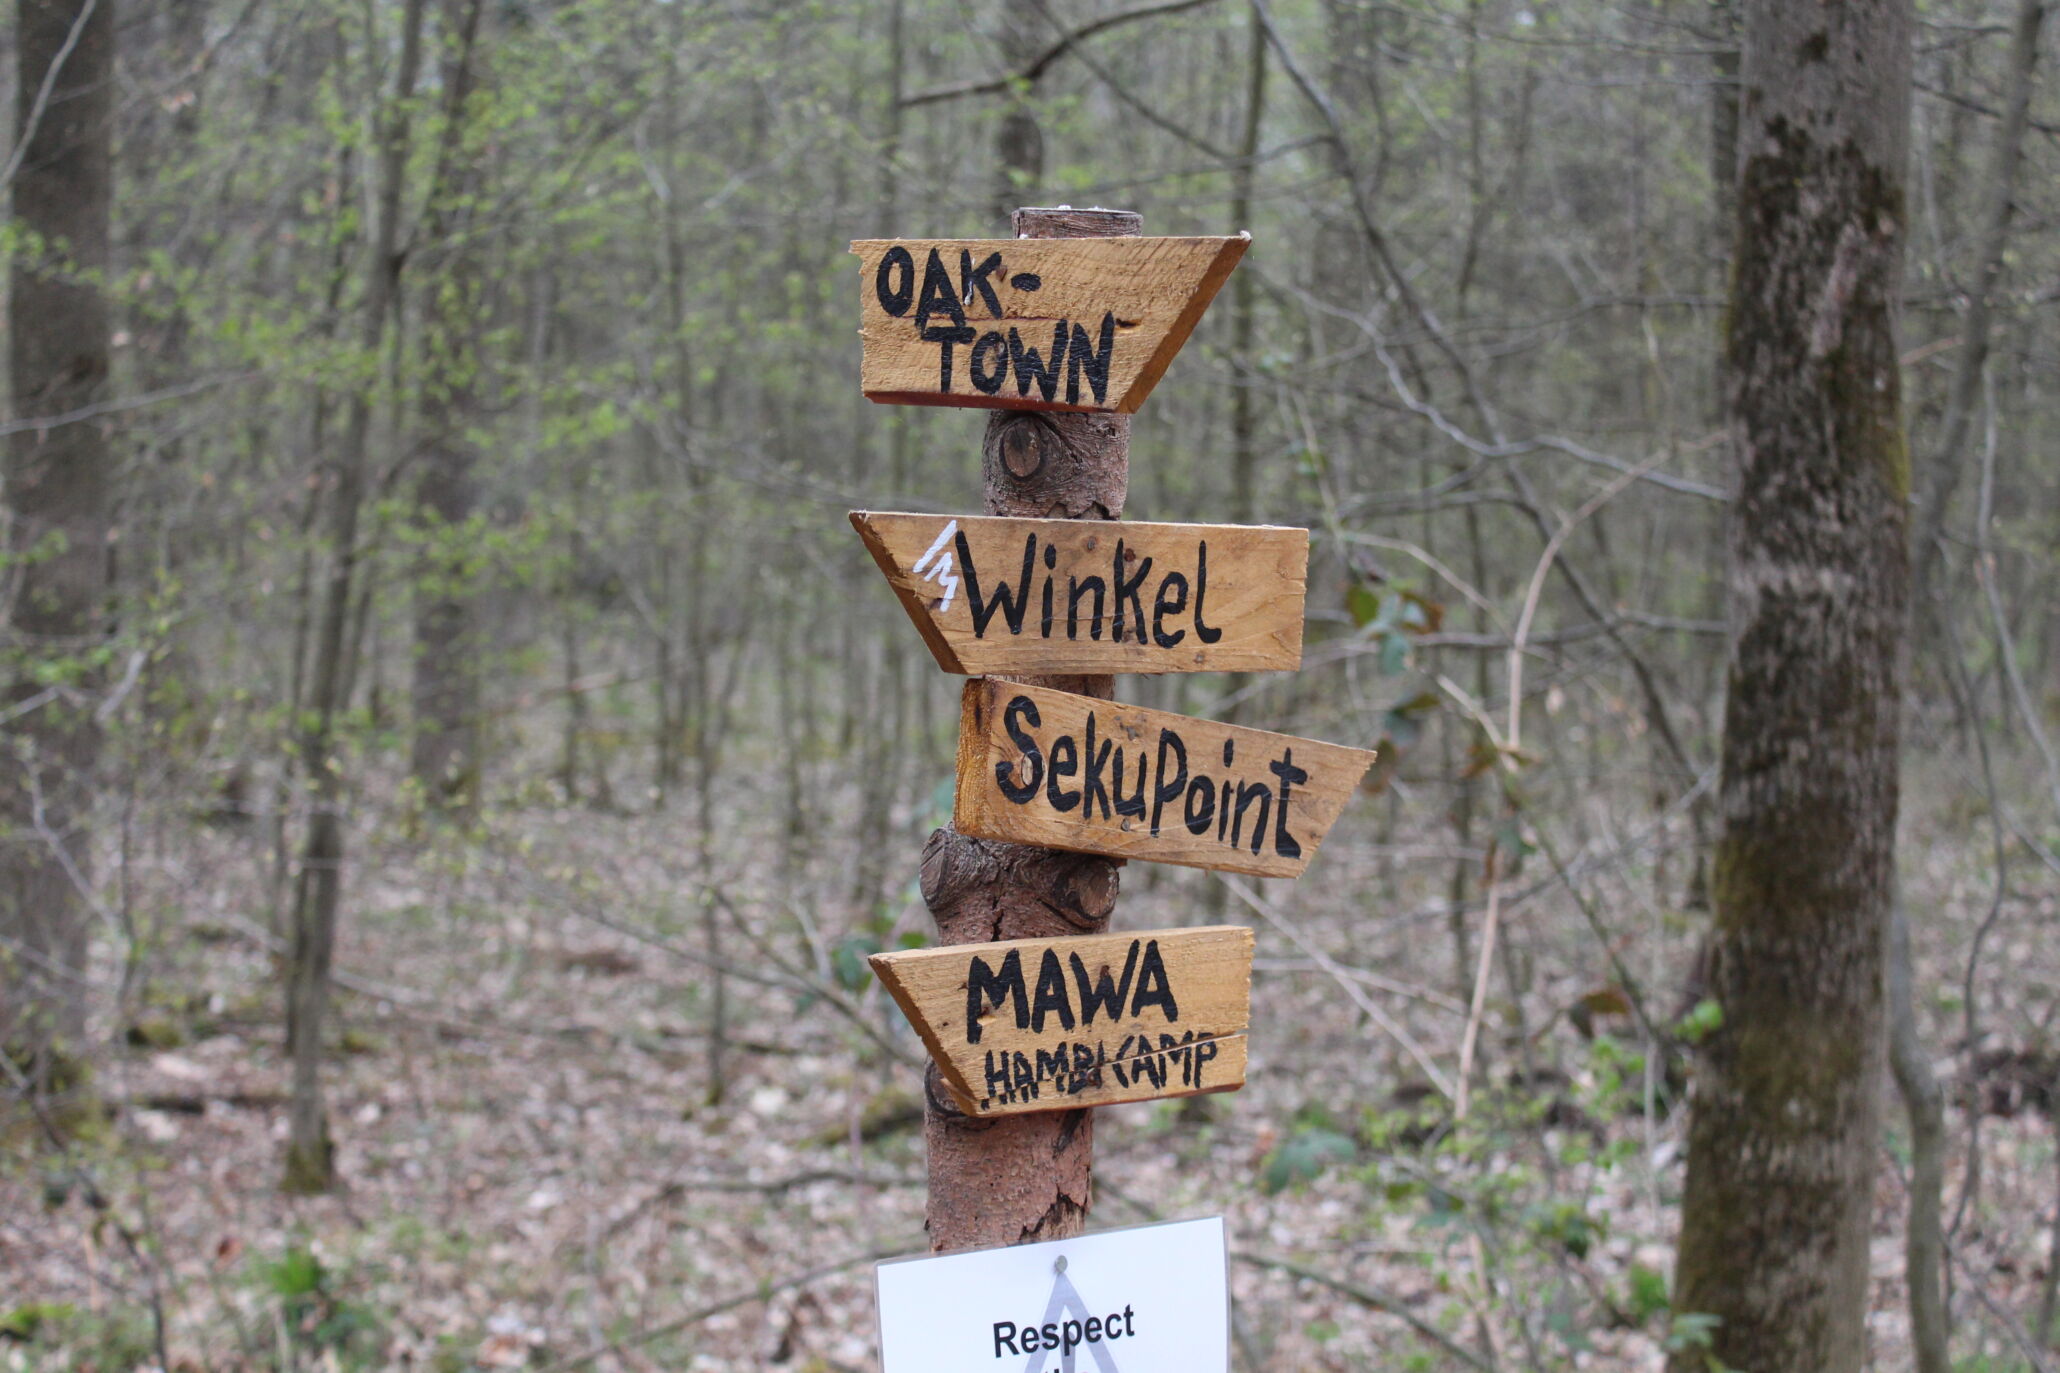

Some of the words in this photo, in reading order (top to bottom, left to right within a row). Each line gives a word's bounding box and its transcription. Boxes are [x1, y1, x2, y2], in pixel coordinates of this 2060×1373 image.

[921, 310, 1116, 404] TOWN
[955, 529, 1222, 648] Winkel
[966, 939, 1179, 1044] MAWA
[993, 1304, 1135, 1358] Respect
